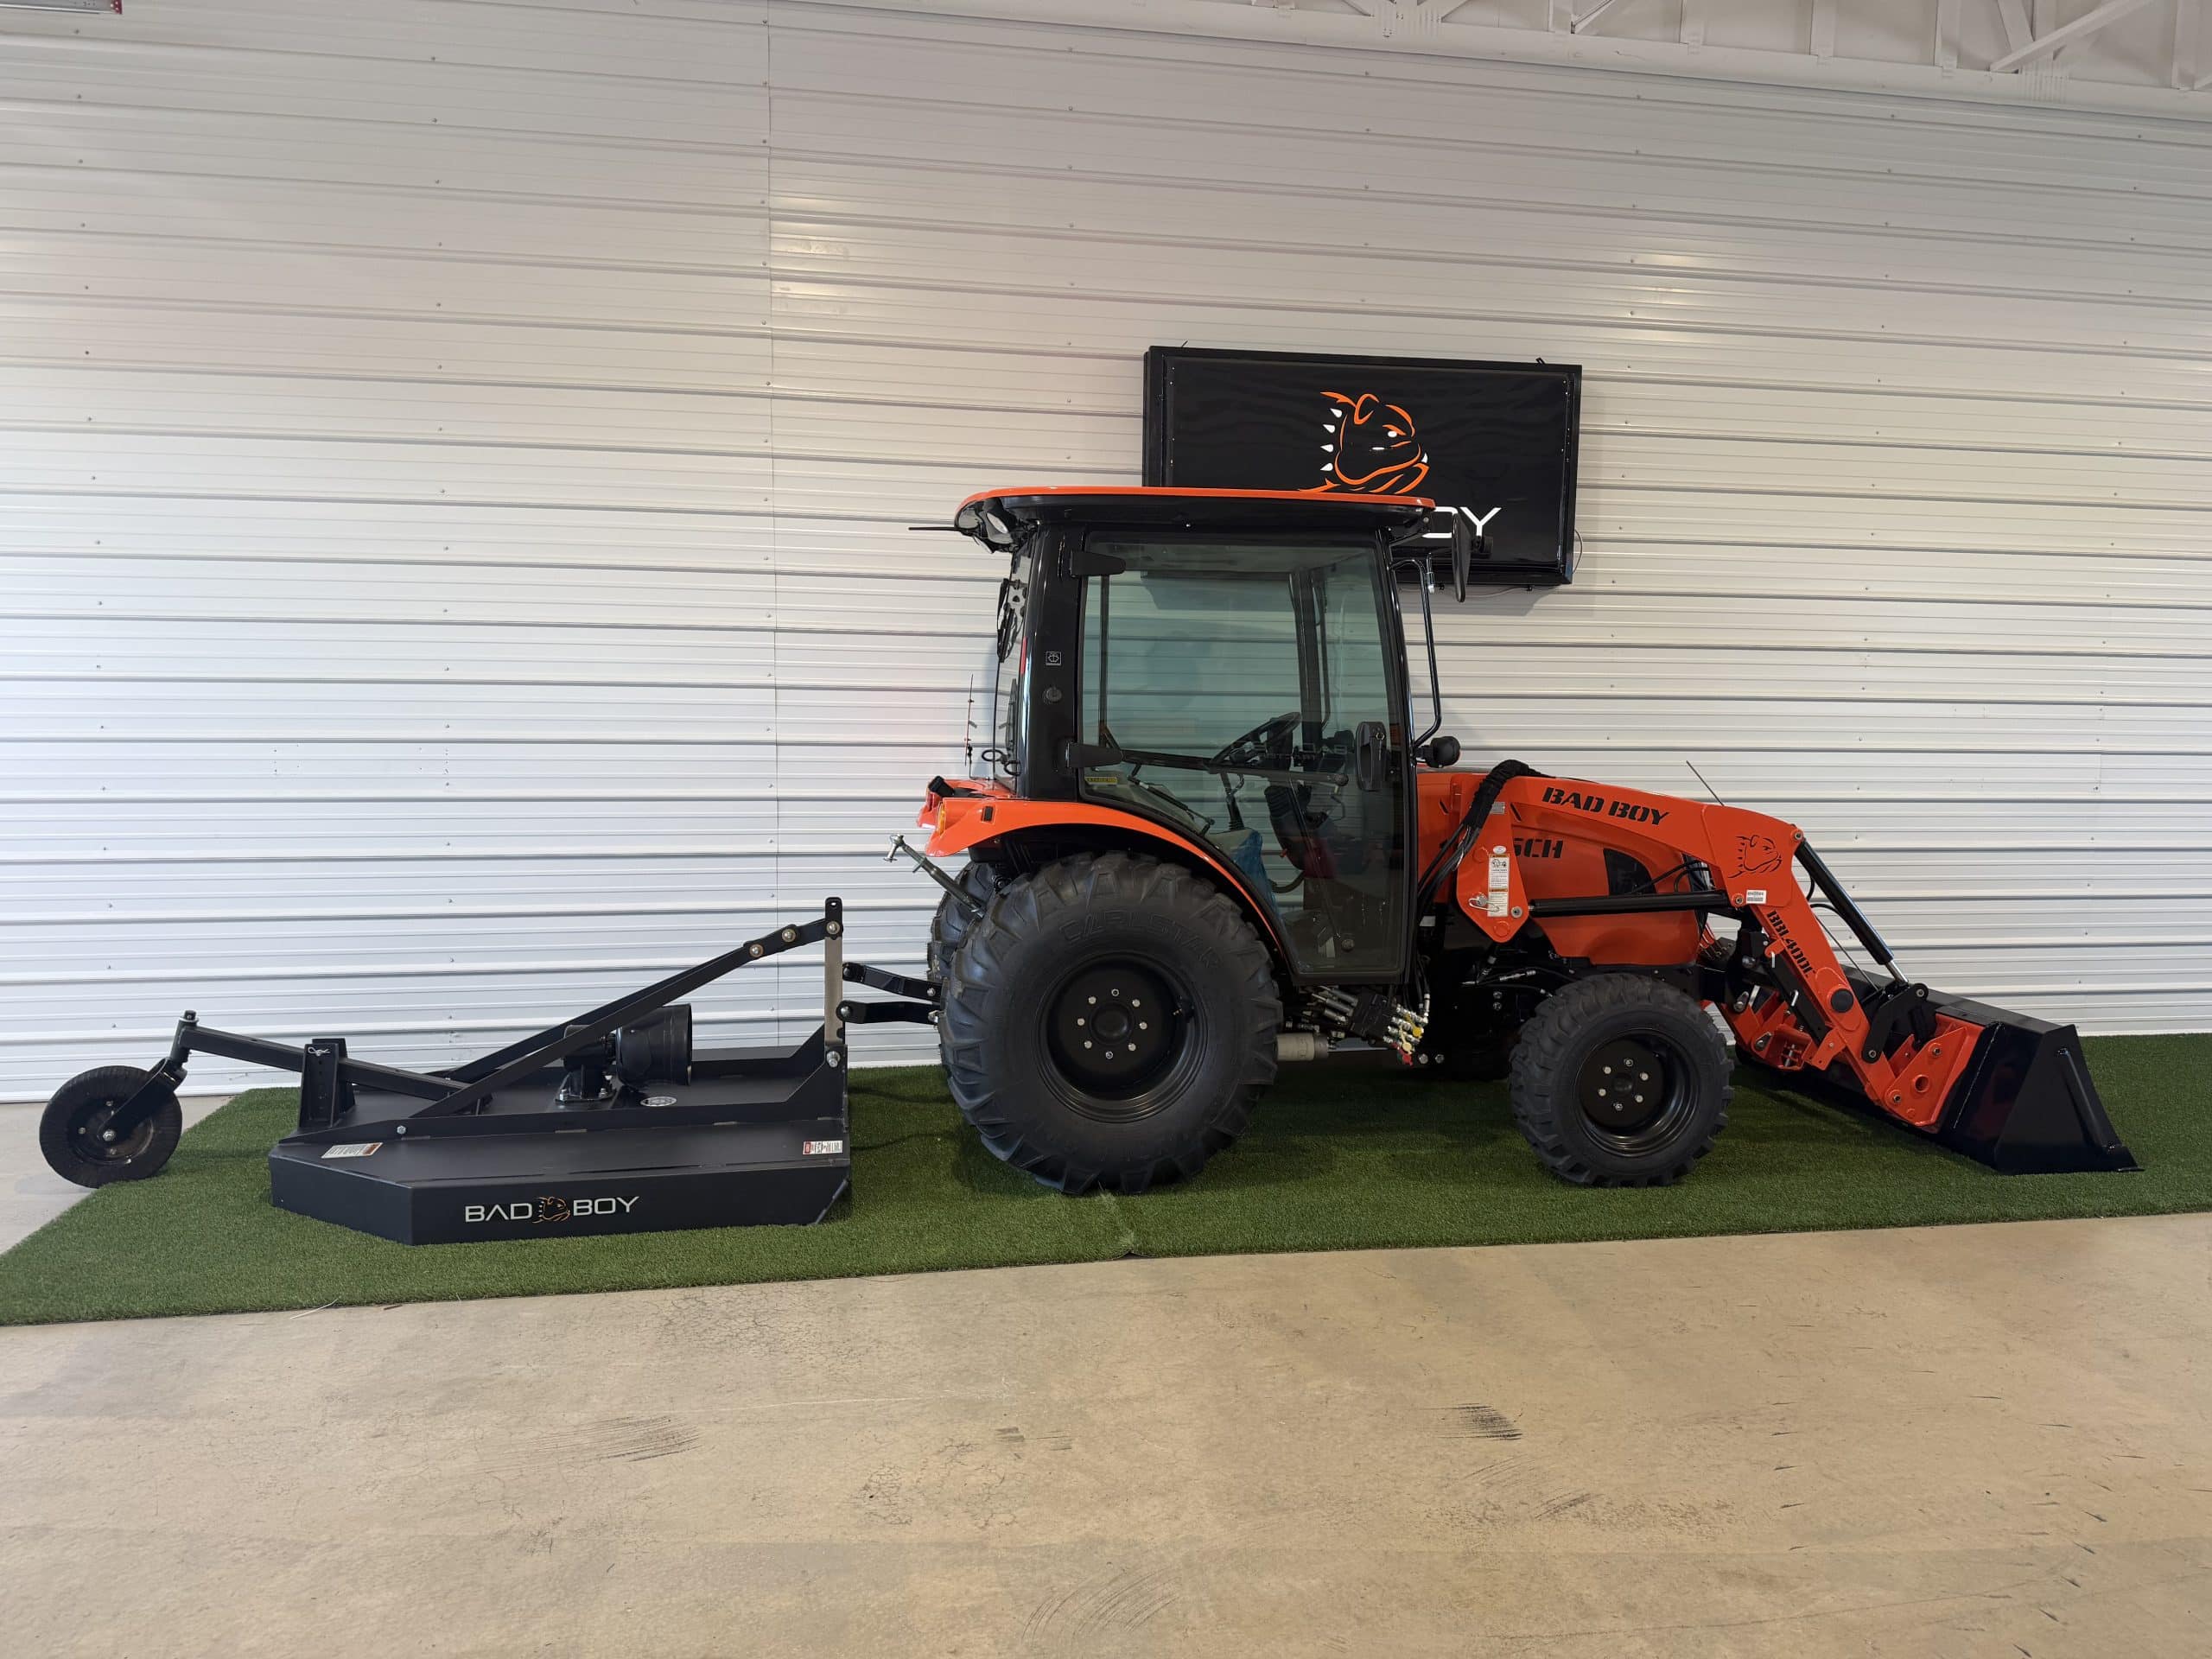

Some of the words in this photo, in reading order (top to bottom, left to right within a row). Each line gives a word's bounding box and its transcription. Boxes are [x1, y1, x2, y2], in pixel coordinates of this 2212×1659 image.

[1421, 505, 1502, 537] OY
[1541, 787, 1605, 812] BAD
[1608, 801, 1669, 825] BOY
[465, 1203, 533, 1223] BAD
[573, 1196, 639, 1217] BOY
